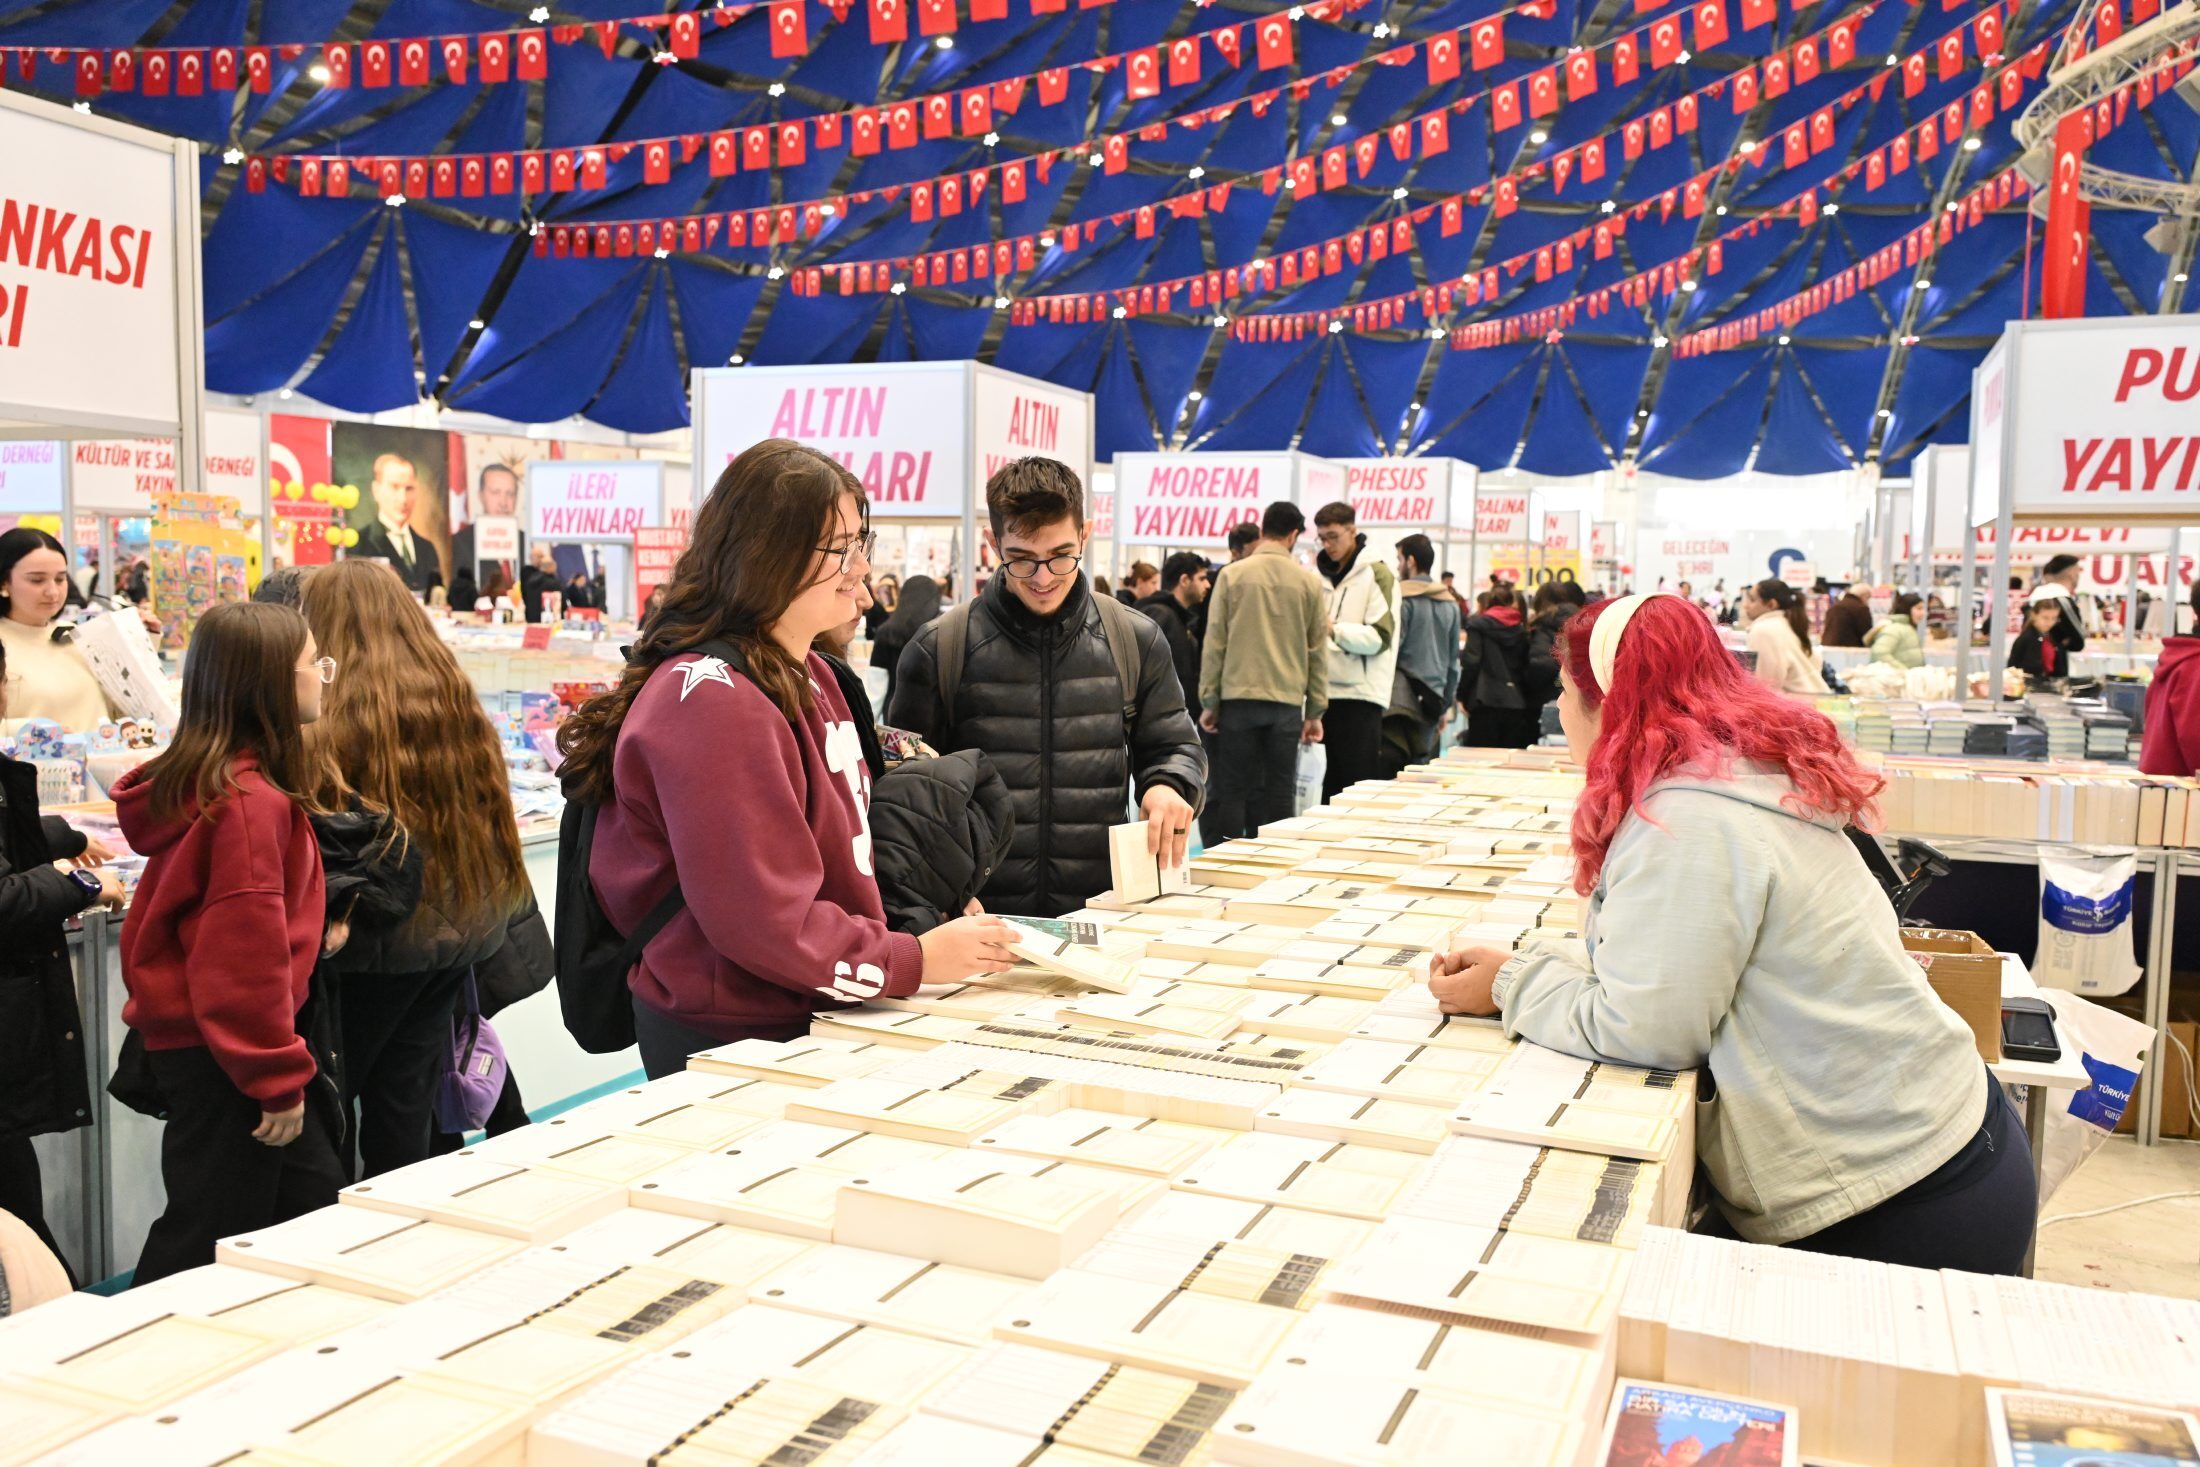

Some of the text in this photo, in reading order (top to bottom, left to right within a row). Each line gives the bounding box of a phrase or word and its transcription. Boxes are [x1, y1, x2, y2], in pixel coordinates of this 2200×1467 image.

[2114, 347, 2200, 402] PU
[769, 386, 887, 438] ALTIN
[1007, 396, 1059, 451] ALTIN
[76, 441, 131, 466] KÜLTÜR
[136, 449, 151, 469] VE
[2062, 436, 2200, 492] YAYI
[1147, 466, 1260, 498] MORENA
[541, 507, 646, 534] YAYINLARI
